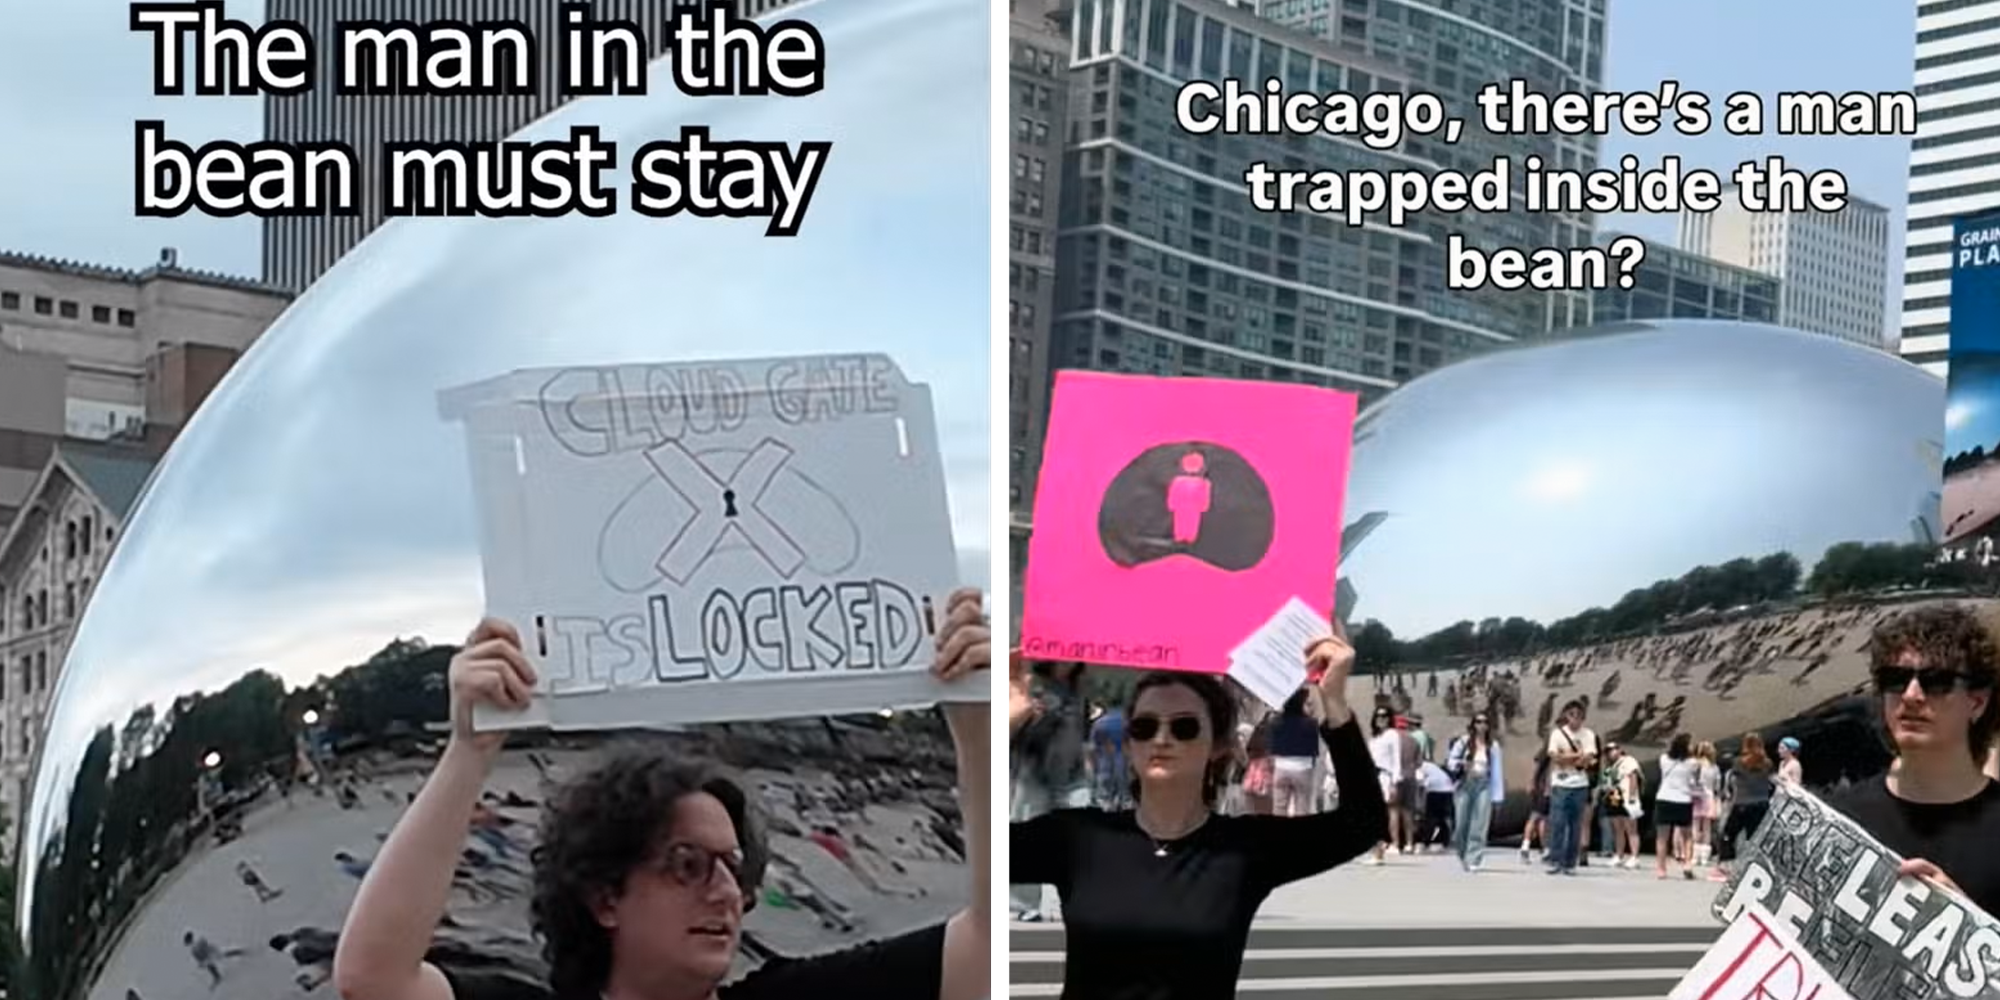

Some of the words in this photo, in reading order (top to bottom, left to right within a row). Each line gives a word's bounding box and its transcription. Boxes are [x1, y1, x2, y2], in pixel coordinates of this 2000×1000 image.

[539, 365, 748, 457] CLOUD
[766, 353, 898, 425] GATE
[549, 613, 653, 691] IS
[648, 579, 922, 682] LOCKED
